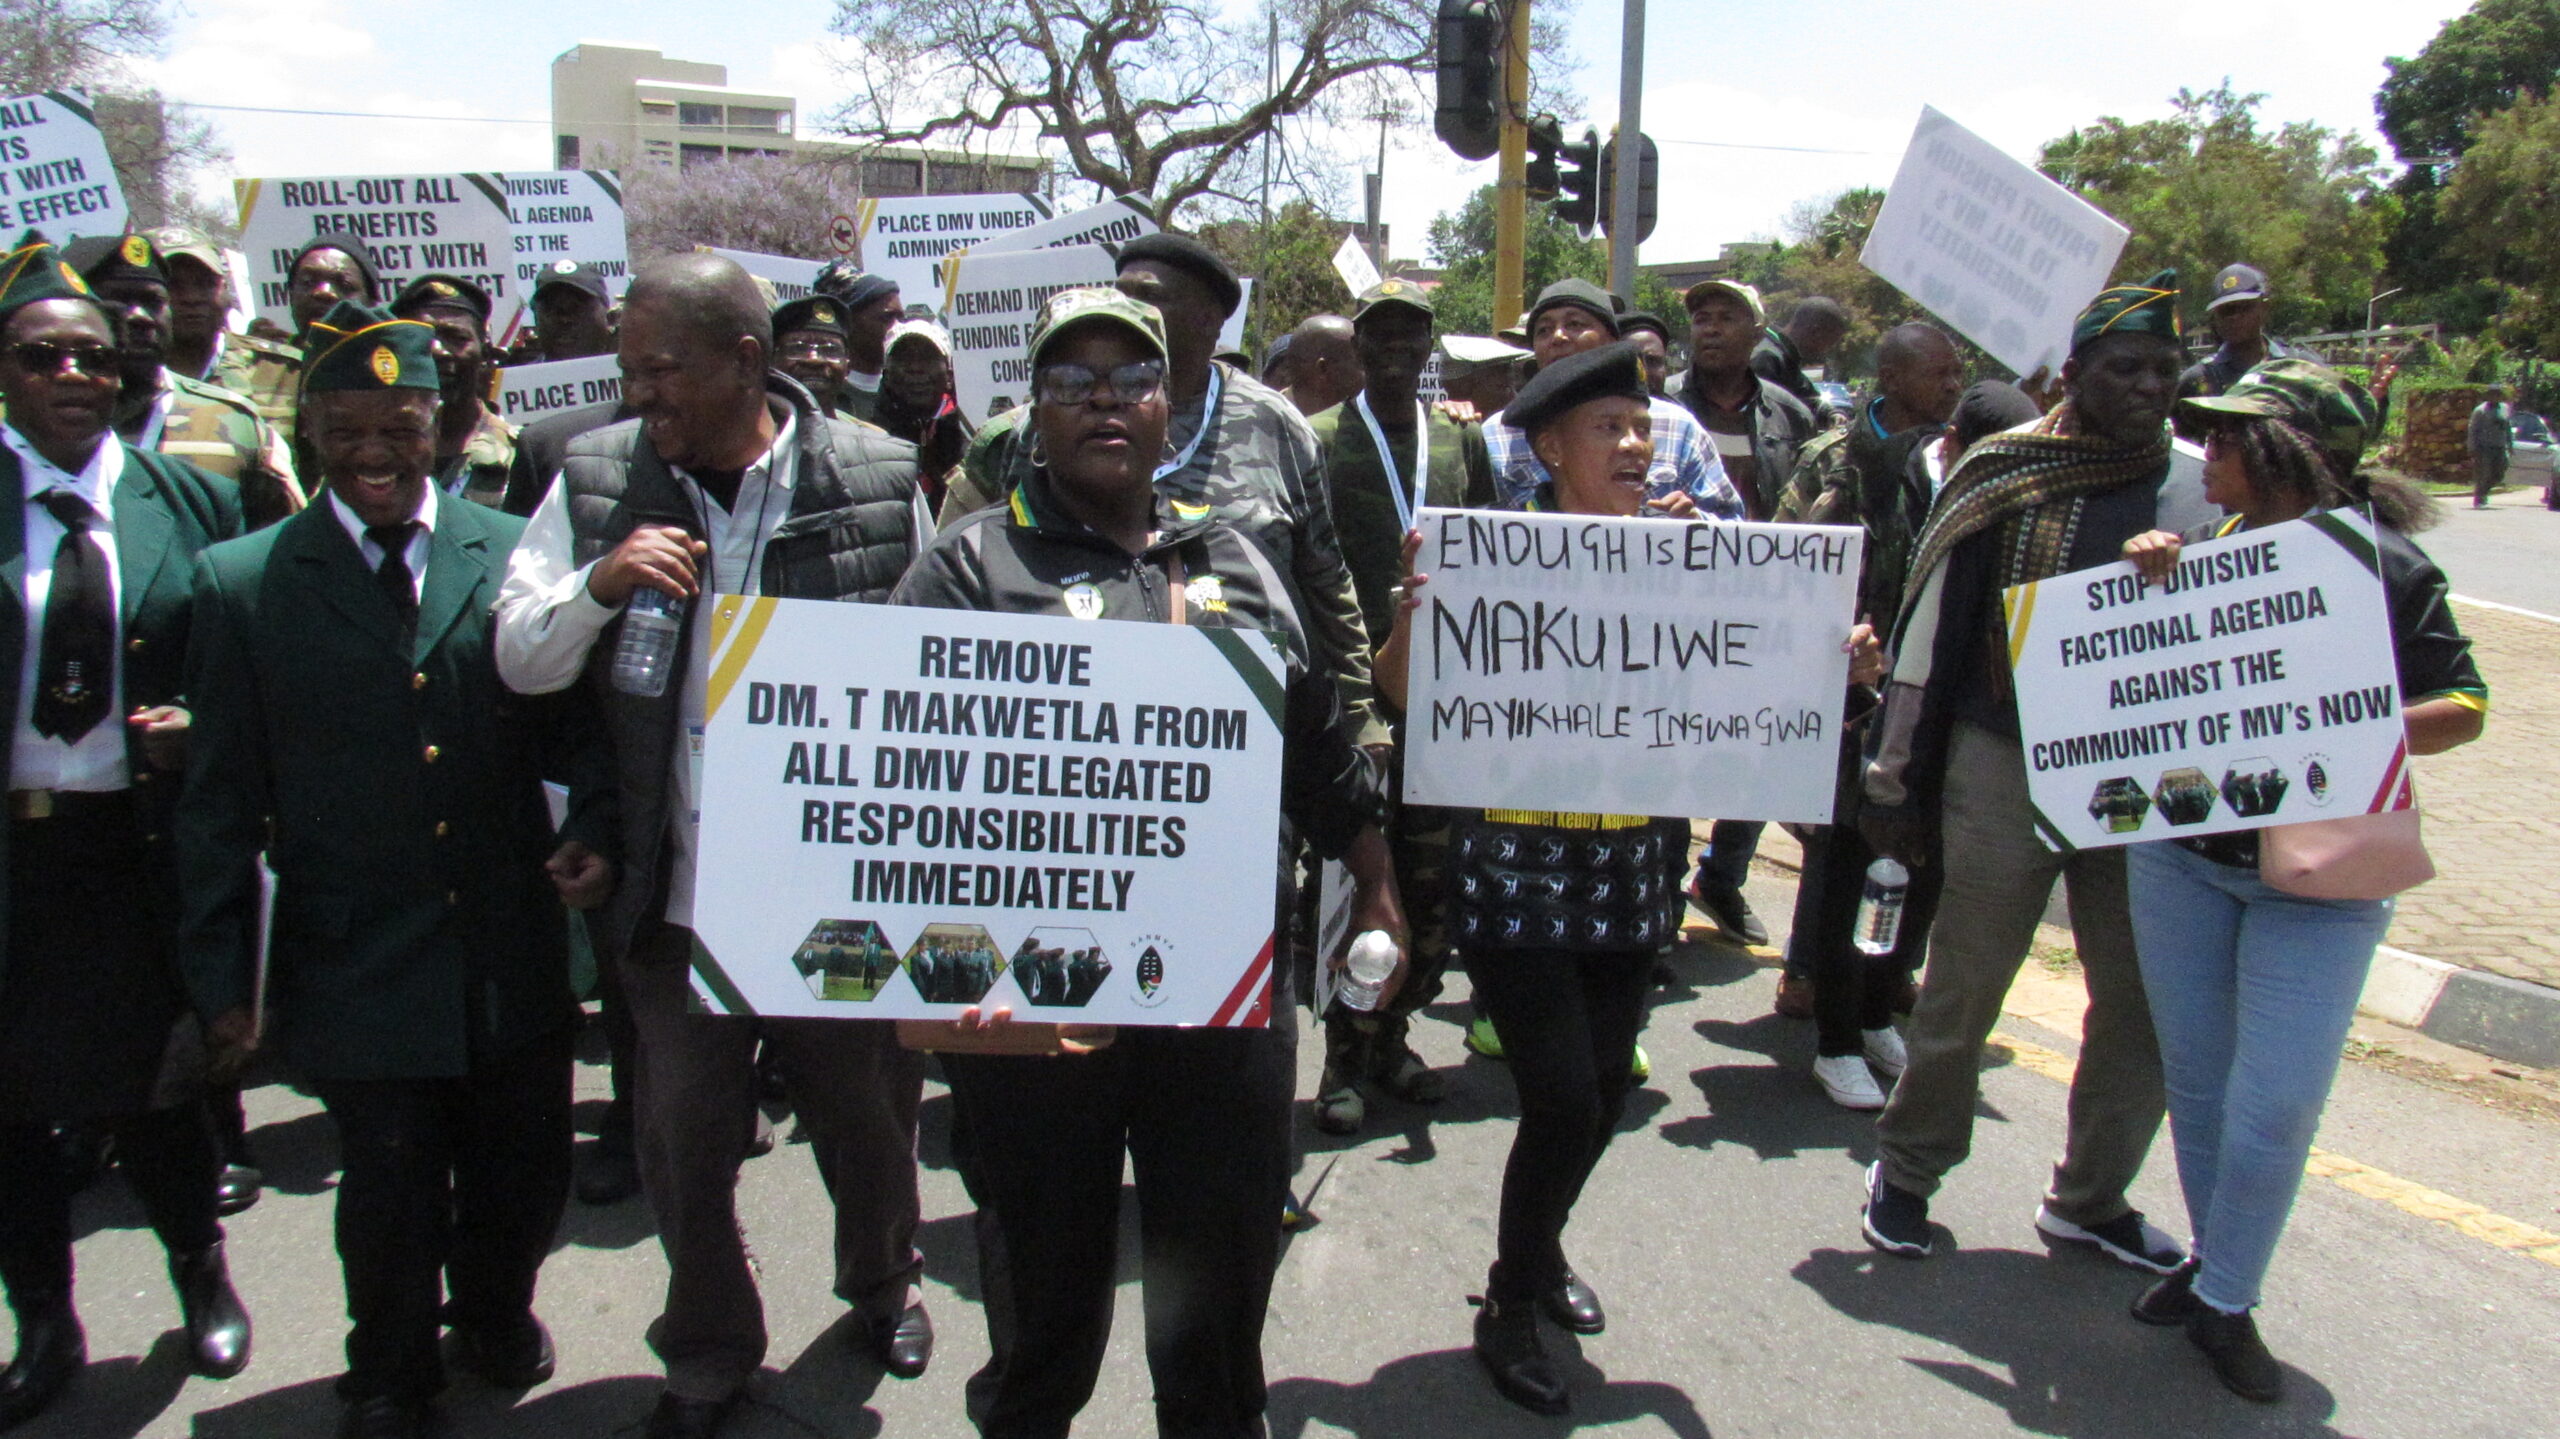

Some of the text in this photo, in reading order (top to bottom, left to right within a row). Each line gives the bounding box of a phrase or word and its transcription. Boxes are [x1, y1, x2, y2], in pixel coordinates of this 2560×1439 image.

[0, 101, 47, 130] ALL
[17, 157, 86, 191] WITH
[281, 178, 461, 207] ROLL-OUT ALL
[18, 185, 110, 224] EFFECT
[527, 206, 594, 223] AGENDA
[878, 210, 1036, 233] PLACE DMV UNDER
[422, 243, 488, 268] WITH
[538, 234, 570, 251] THE
[517, 263, 537, 280] OF
[598, 260, 626, 277] OW
[956, 288, 1023, 316] DEMAND
[953, 323, 1020, 350] FUNDING
[505, 376, 622, 414] PLACE DM
[1439, 514, 1627, 573] ENOUGH
[1684, 523, 1847, 575] ENOUGH
[2086, 572, 2150, 612] STOP
[1433, 595, 1759, 680] MAKULIWE
[2059, 586, 2327, 667] FACTIONAL AGENDA
[920, 635, 1092, 686] REMOVE
[2109, 649, 2285, 710] AGAINST THE
[747, 682, 1247, 750] DM. T MAKWETLA FROM
[2032, 685, 2393, 772] COMMUNITY OF MV's NOW
[783, 741, 1211, 803] ALL DMV DELEGATED
[801, 800, 1186, 858] RESPONSIBILITIES
[851, 860, 1134, 911] IMMEDIATELY
